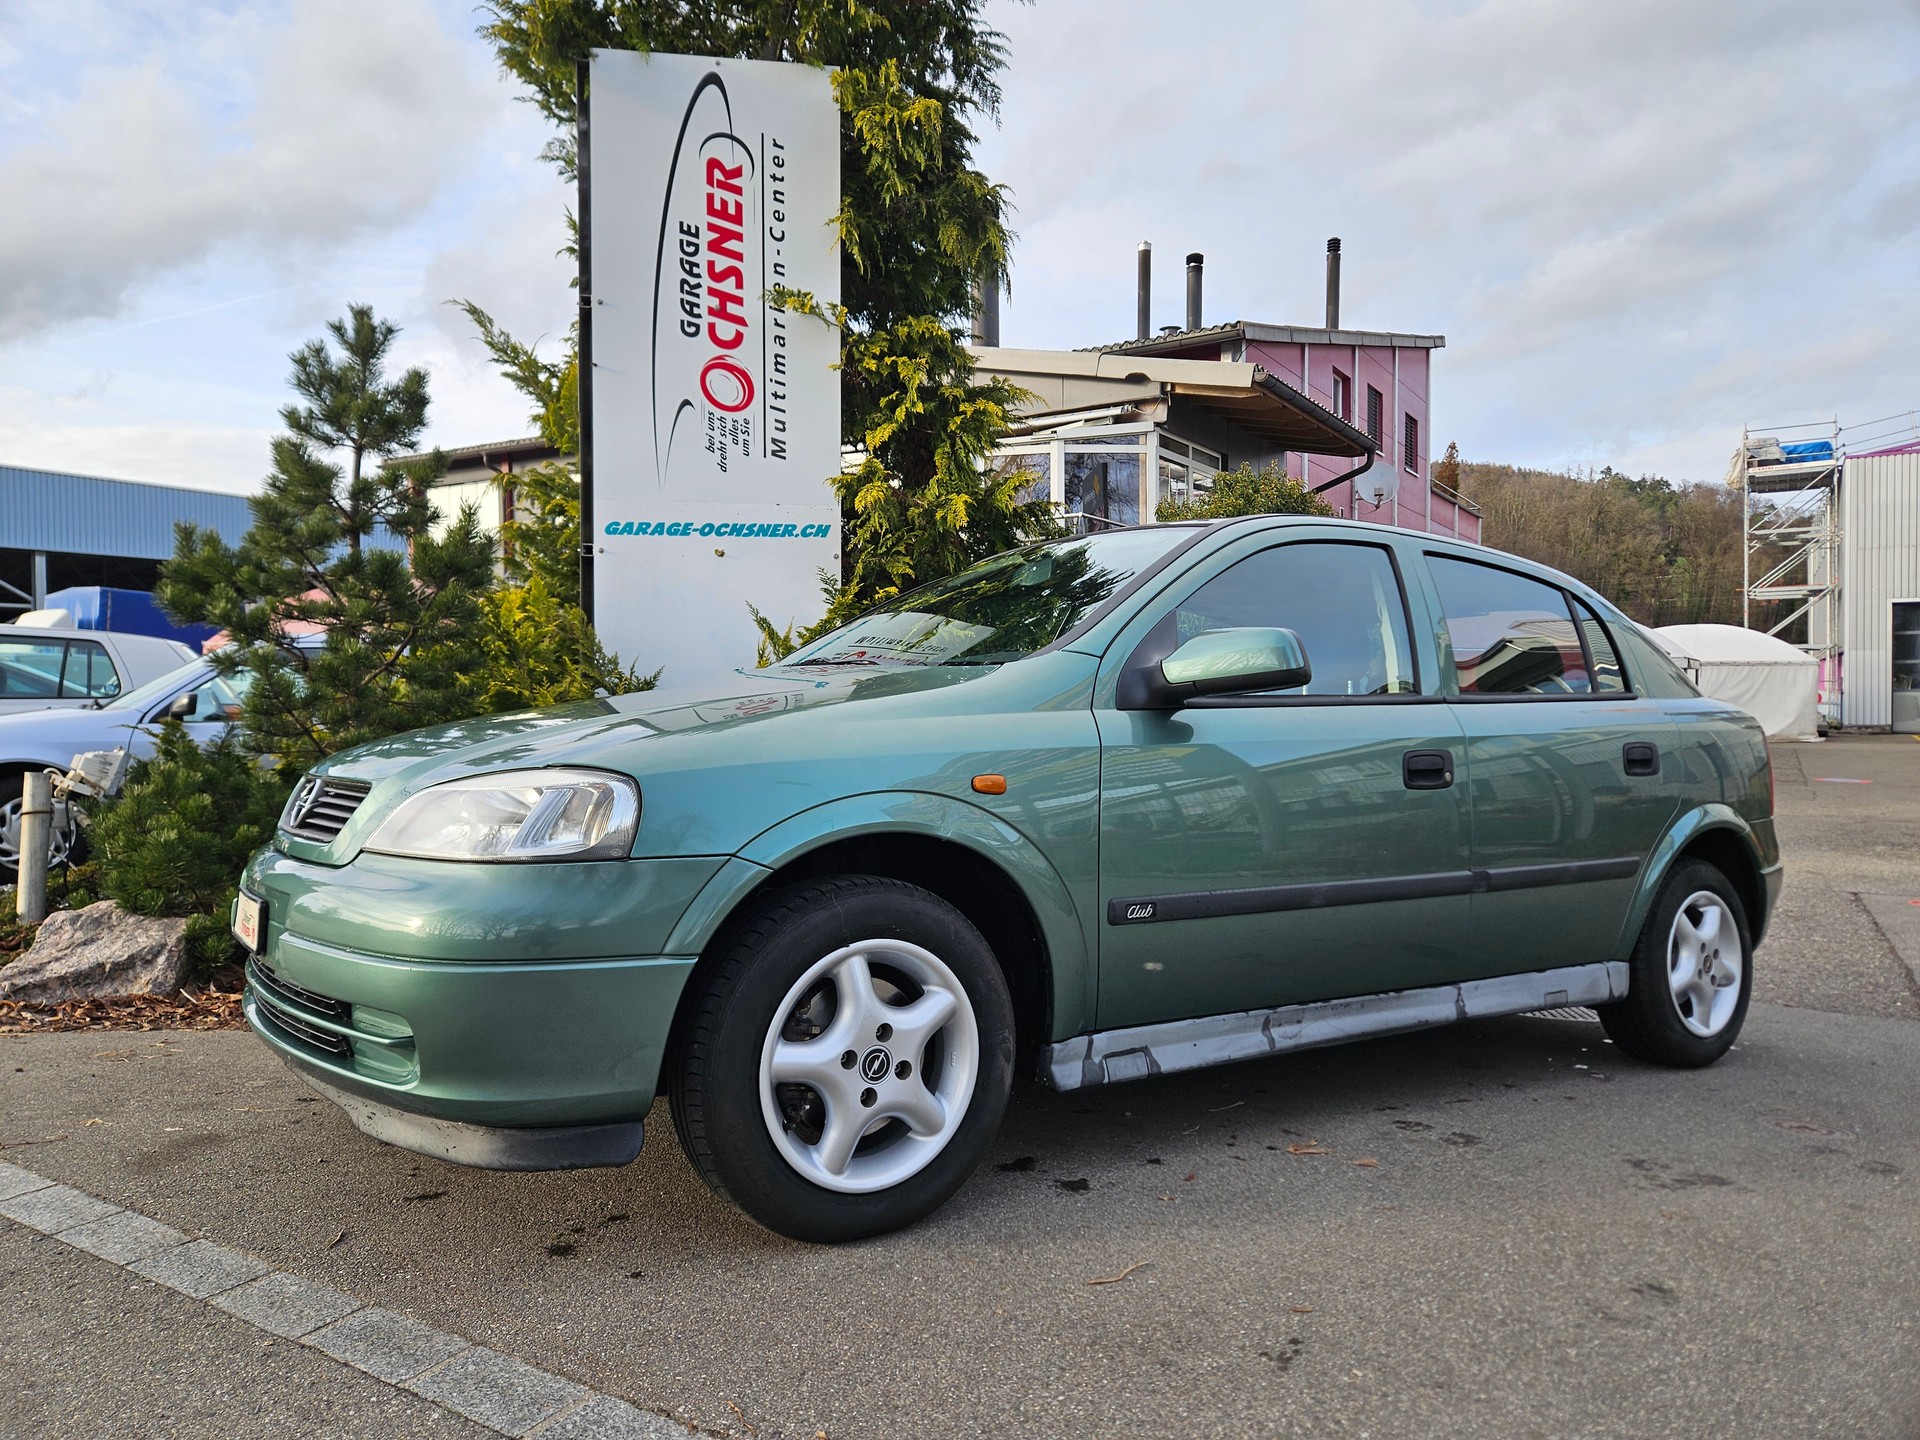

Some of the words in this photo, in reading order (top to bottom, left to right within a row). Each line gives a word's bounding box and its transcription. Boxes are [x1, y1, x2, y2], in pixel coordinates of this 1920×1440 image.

[679, 220, 703, 338] GARAGE
[716, 415, 727, 439] sich
[728, 417, 739, 446] alles
[740, 417, 750, 437] Sie
[705, 432, 715, 454] bei
[742, 438, 750, 457] um
[717, 440, 728, 473] dreht
[604, 521, 831, 538] GARAGE-OCHSNER.CH
[1127, 904, 1153, 919] Club
